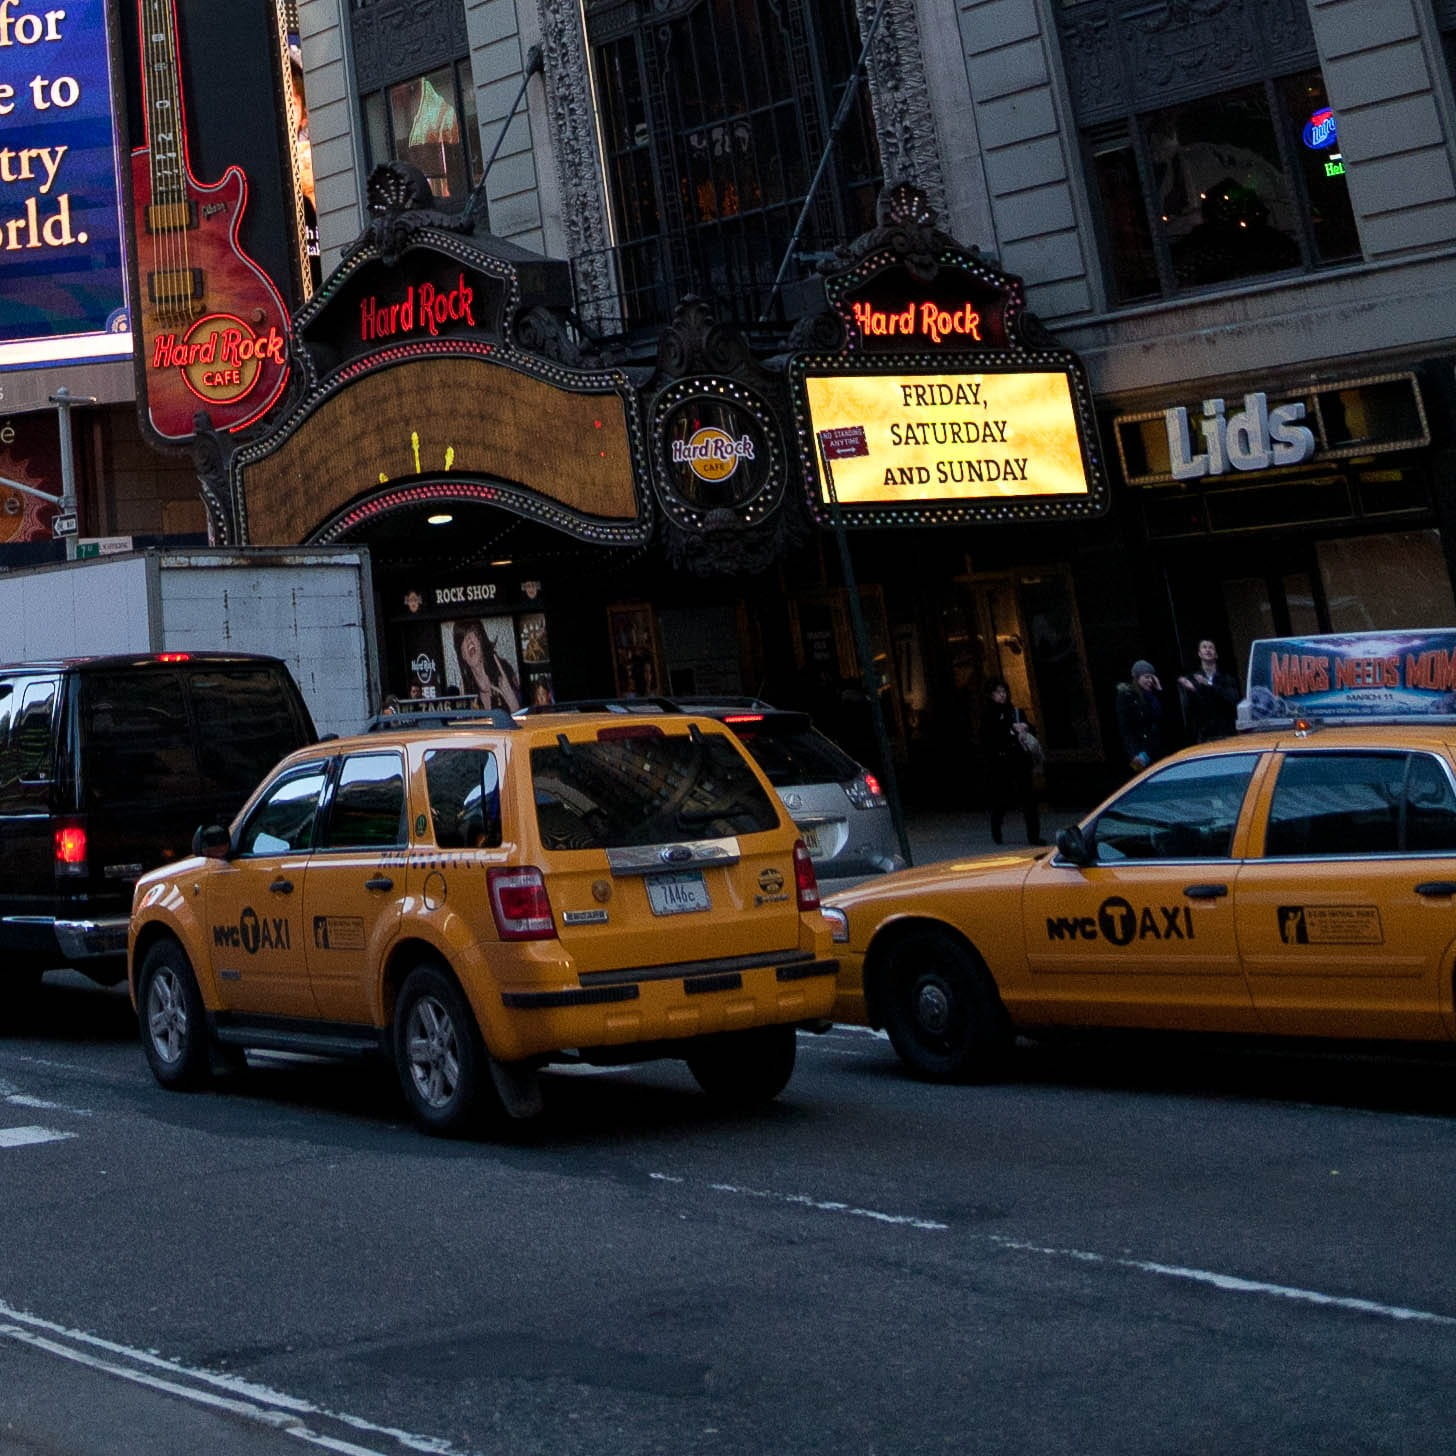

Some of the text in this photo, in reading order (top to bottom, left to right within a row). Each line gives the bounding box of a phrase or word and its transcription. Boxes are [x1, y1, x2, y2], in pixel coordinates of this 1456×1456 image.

[29, 74, 82, 111] to
[361, 273, 475, 340] Hard Rock
[853, 301, 981, 343] Hard Rock
[153, 327, 285, 368] Hard Rock
[203, 370, 241, 387] CAFE
[901, 383, 988, 408] FRIDAY,
[672, 435, 755, 463] Hard Rock
[830, 438, 860, 448] ANYTIME
[890, 421, 1008, 449] SATURDAY
[1165, 392, 1315, 480] Lids
[703, 462, 726, 474] CAFE
[883, 457, 1029, 487] AND SUNDAY
[435, 585, 497, 605] ROCK SHOP
[1271, 651, 1330, 697] MARS
[1335, 655, 1400, 688] NEEDS
[1346, 692, 1394, 701] MARCH 11
[213, 925, 241, 948] NYC
[240, 906, 291, 955] TAXI
[1046, 896, 1194, 947] NYC TAXI
